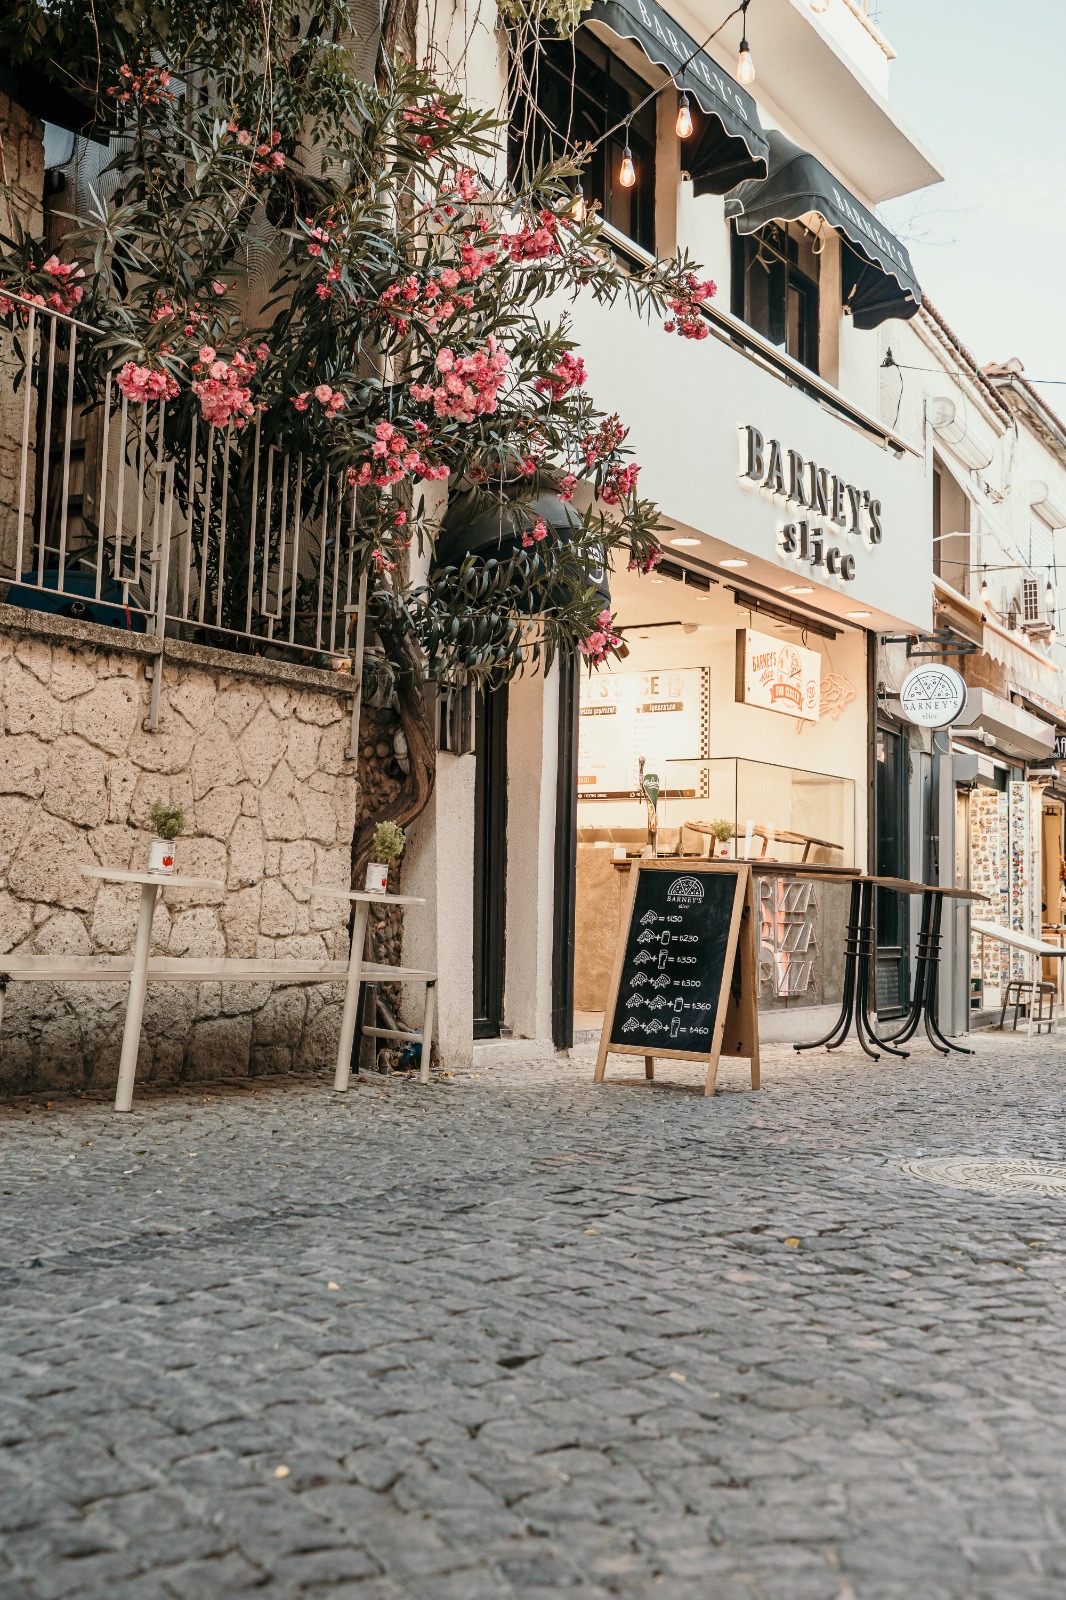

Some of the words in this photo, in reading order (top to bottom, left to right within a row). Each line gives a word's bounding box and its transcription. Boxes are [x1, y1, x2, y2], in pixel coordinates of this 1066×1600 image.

[638, 0, 748, 120] BARNEY'S
[832, 186, 908, 272] BARNEY'S
[744, 424, 882, 545] BARNEY'S
[781, 520, 856, 581] slice
[903, 700, 959, 711] BARNEY'S
[666, 895, 703, 904] BARNEY'S
